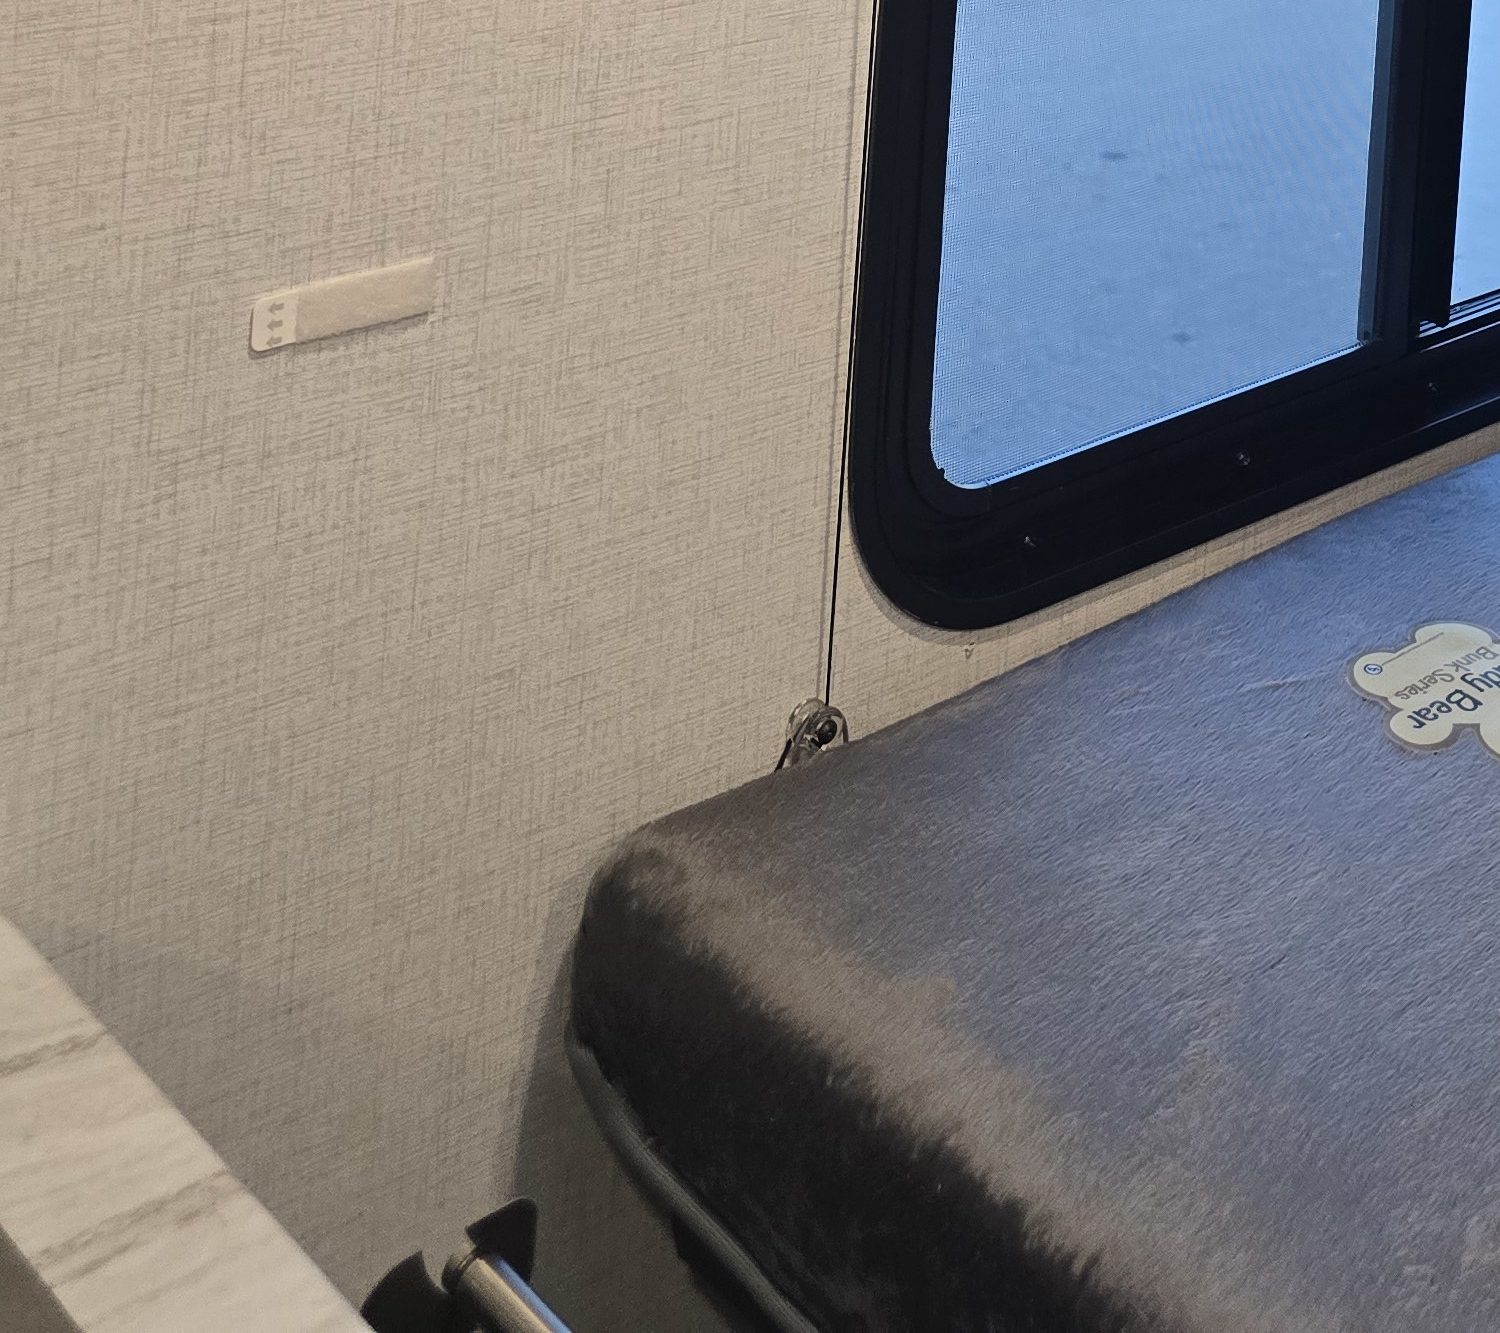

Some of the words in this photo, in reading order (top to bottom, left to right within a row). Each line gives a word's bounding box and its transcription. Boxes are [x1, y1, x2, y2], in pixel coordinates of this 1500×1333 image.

[1444, 645, 1500, 675] Bunk
[1393, 669, 1457, 701] Series
[1406, 688, 1484, 730] Bear
